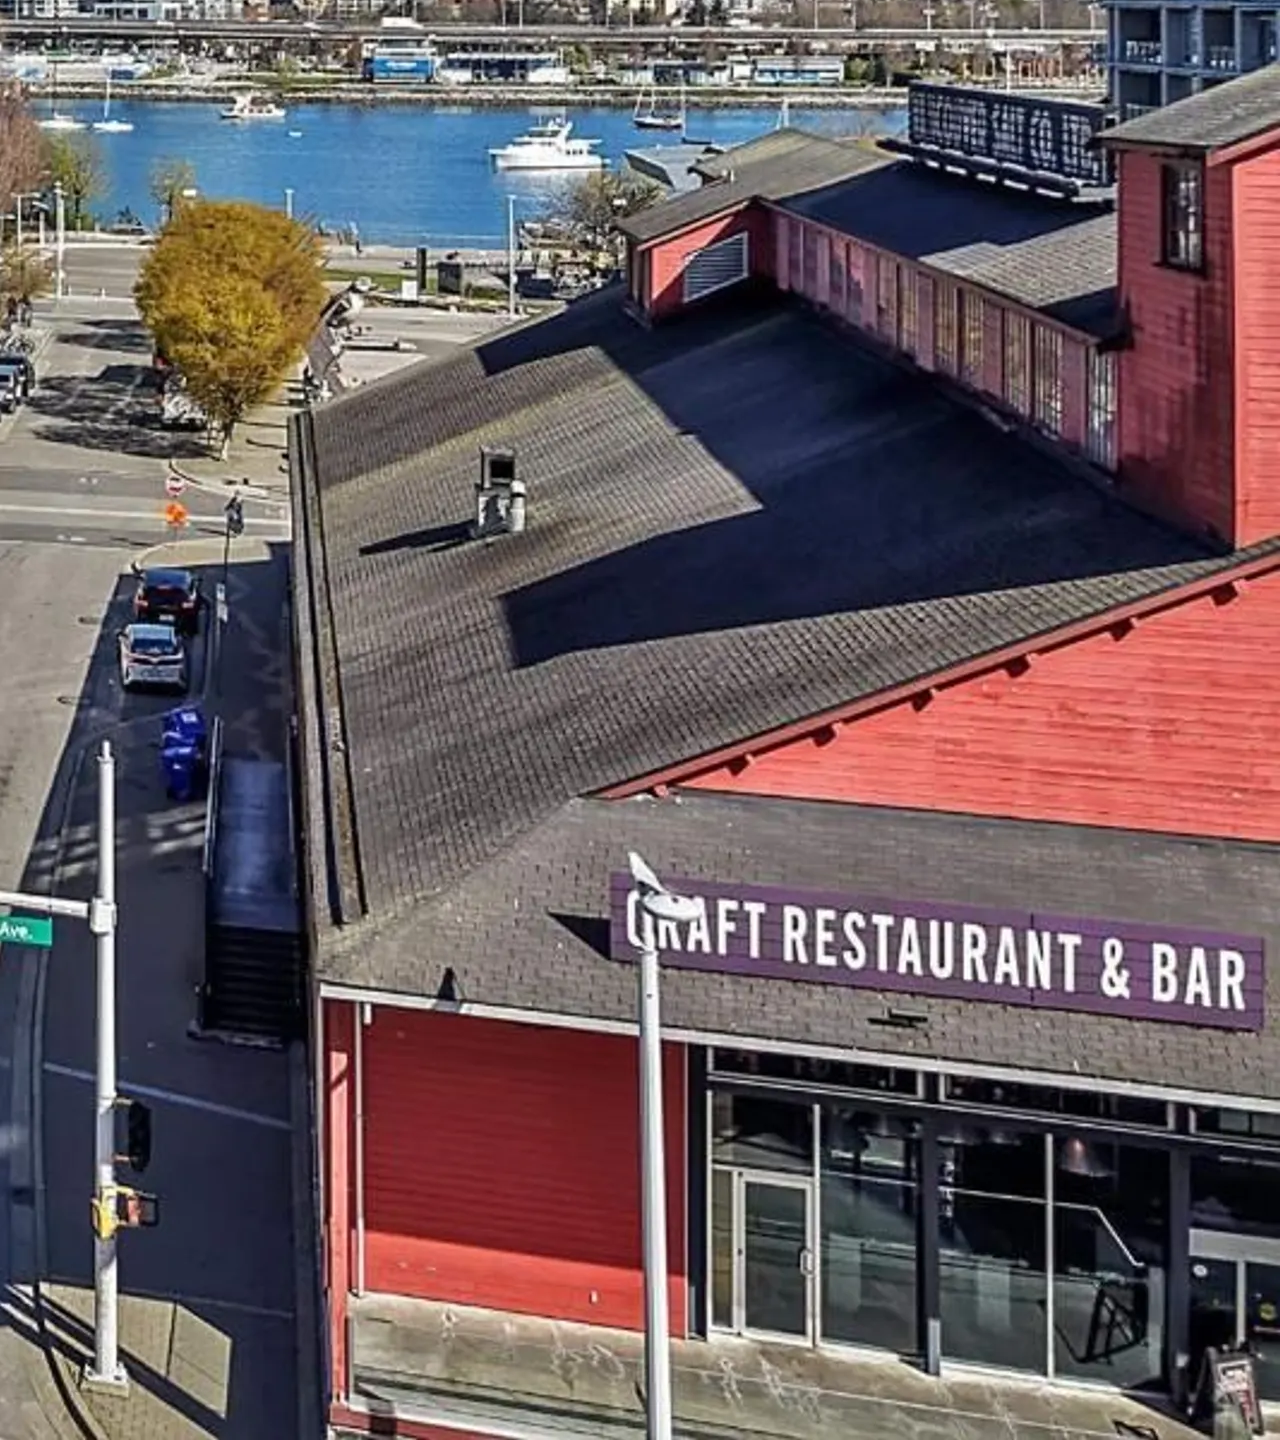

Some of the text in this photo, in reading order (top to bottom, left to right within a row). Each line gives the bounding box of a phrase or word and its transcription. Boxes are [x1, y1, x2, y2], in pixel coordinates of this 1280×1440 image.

[627, 889, 1246, 1011] CRAFT RESTAURANT & BAR
